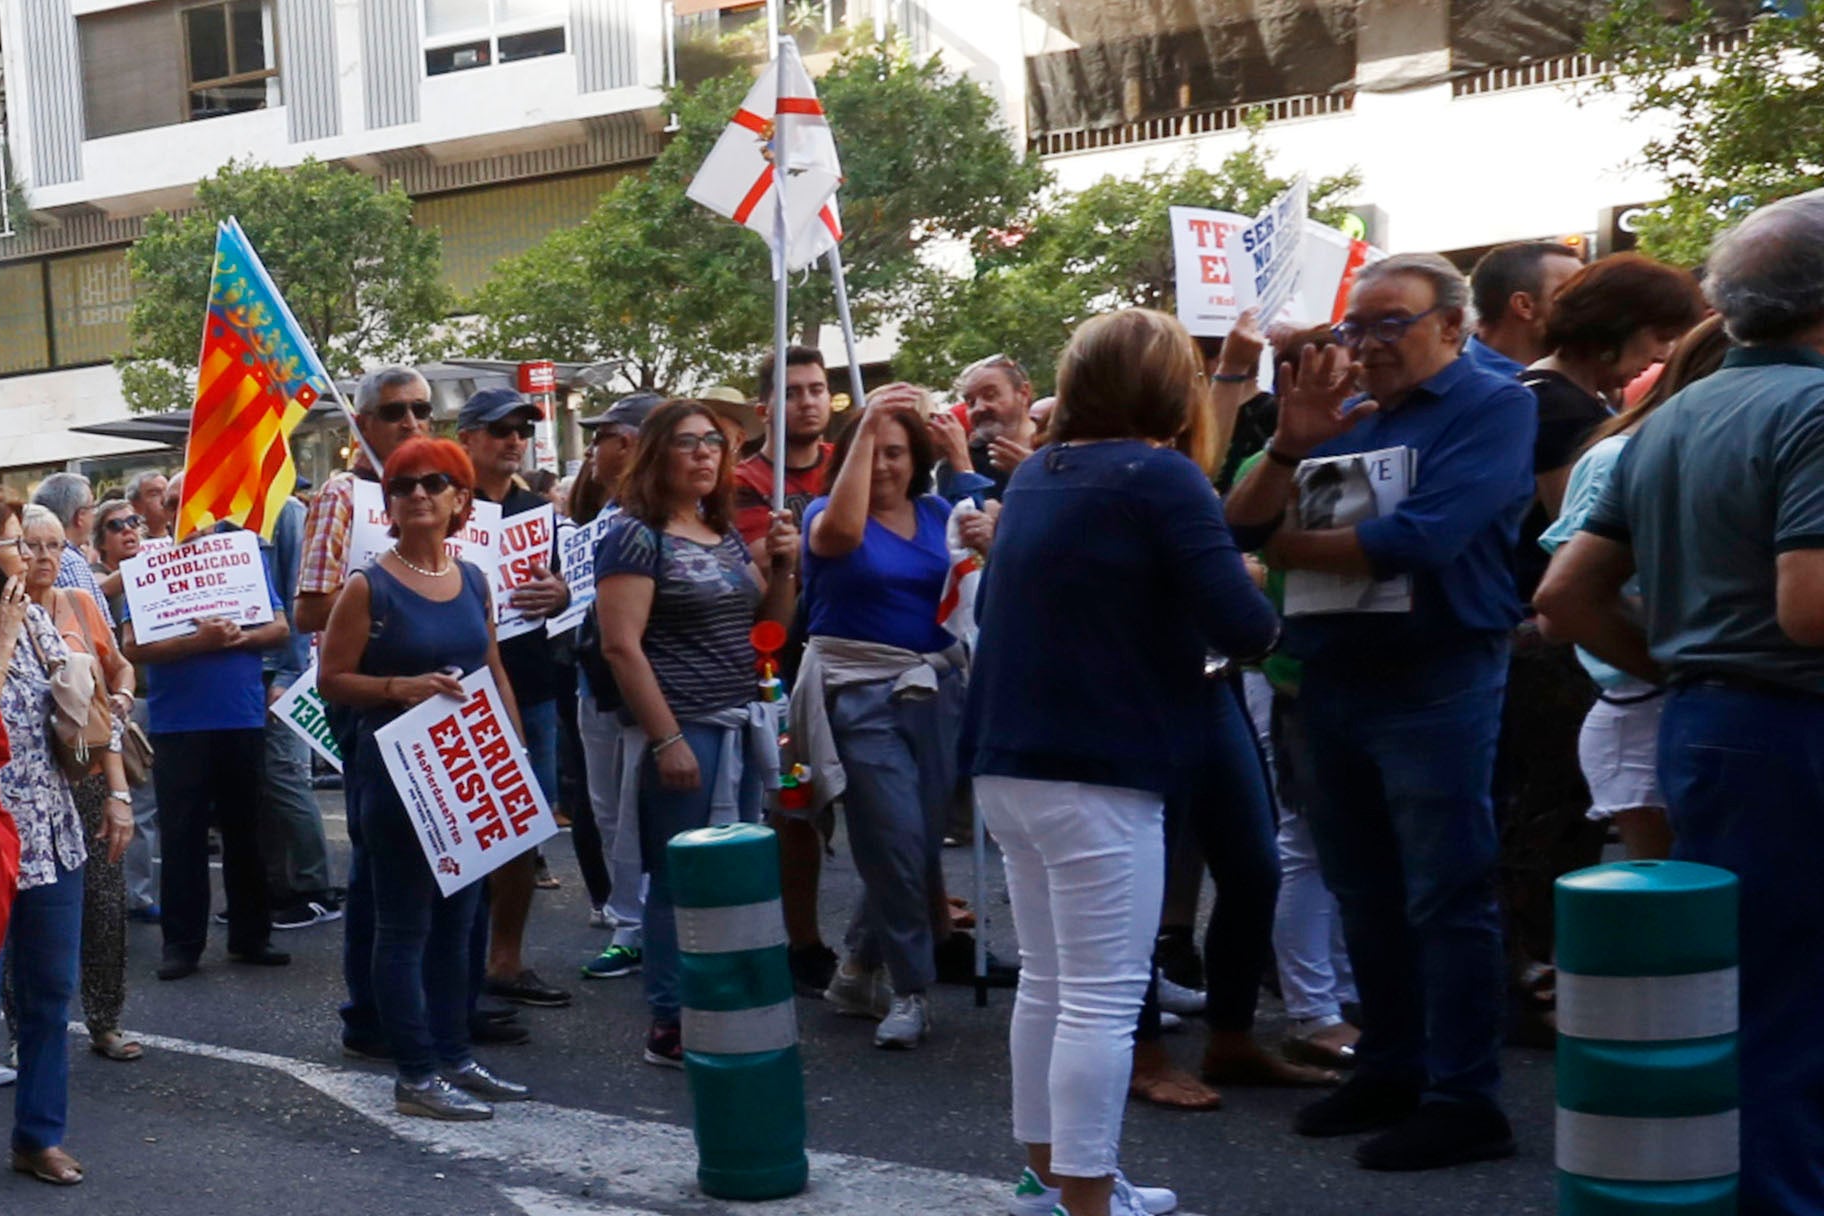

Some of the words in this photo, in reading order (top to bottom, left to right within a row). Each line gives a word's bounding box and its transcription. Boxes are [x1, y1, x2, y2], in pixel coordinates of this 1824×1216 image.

[135, 572, 157, 588] LO
[161, 552, 251, 581] PUBLICADO
[167, 579, 190, 595] EN
[194, 572, 228, 589] BOE
[428, 714, 508, 851] EXISTE
[460, 688, 539, 837] TERUEL
